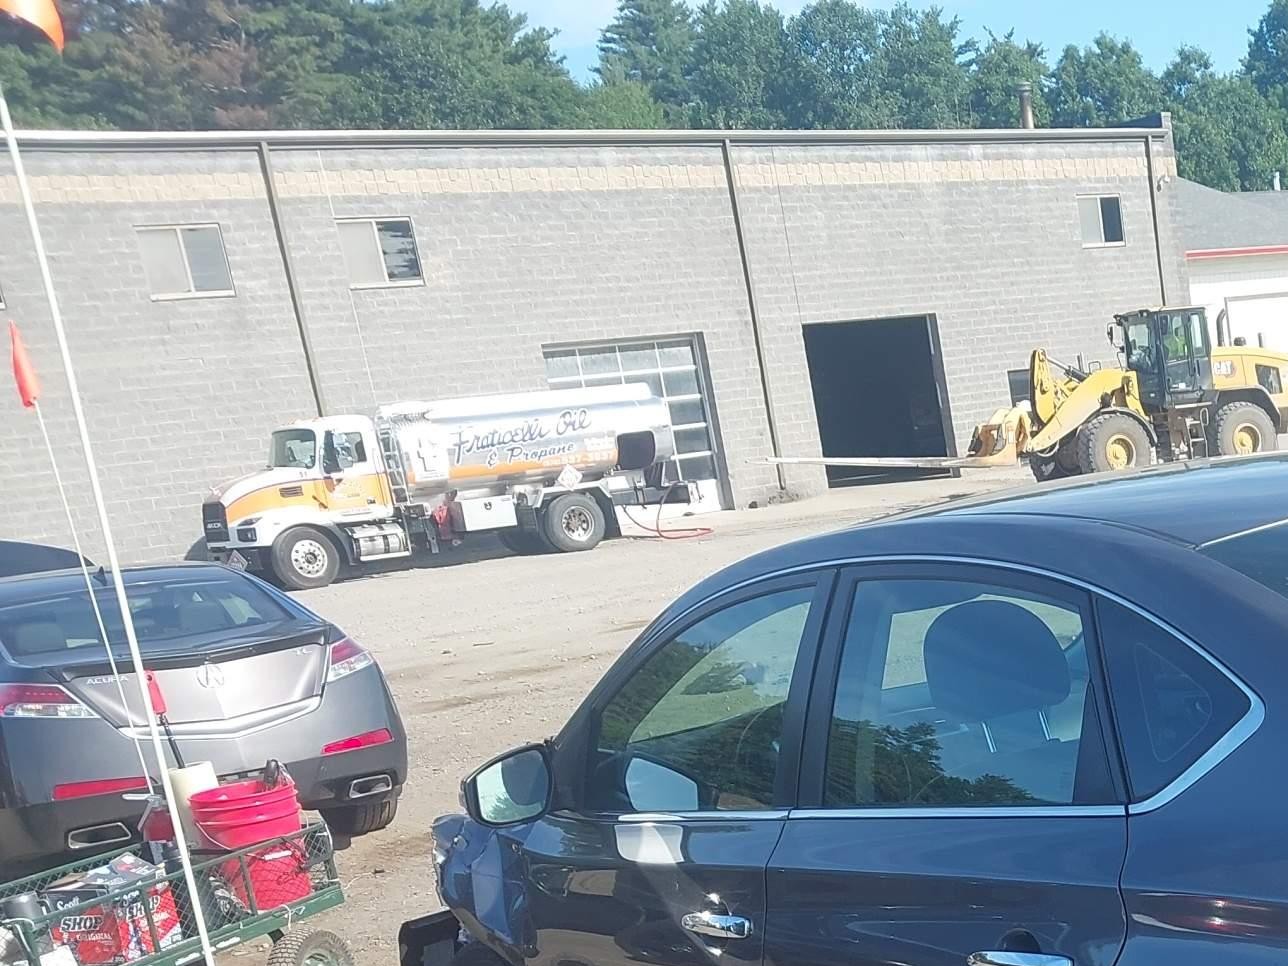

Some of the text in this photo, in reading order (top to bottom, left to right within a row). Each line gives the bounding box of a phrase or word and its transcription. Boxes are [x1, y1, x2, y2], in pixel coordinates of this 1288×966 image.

[1213, 359, 1233, 376] CAT
[450, 407, 593, 465] Fraticelli Oil
[505, 442, 577, 465] Propane
[60, 915, 104, 933] SHOP
